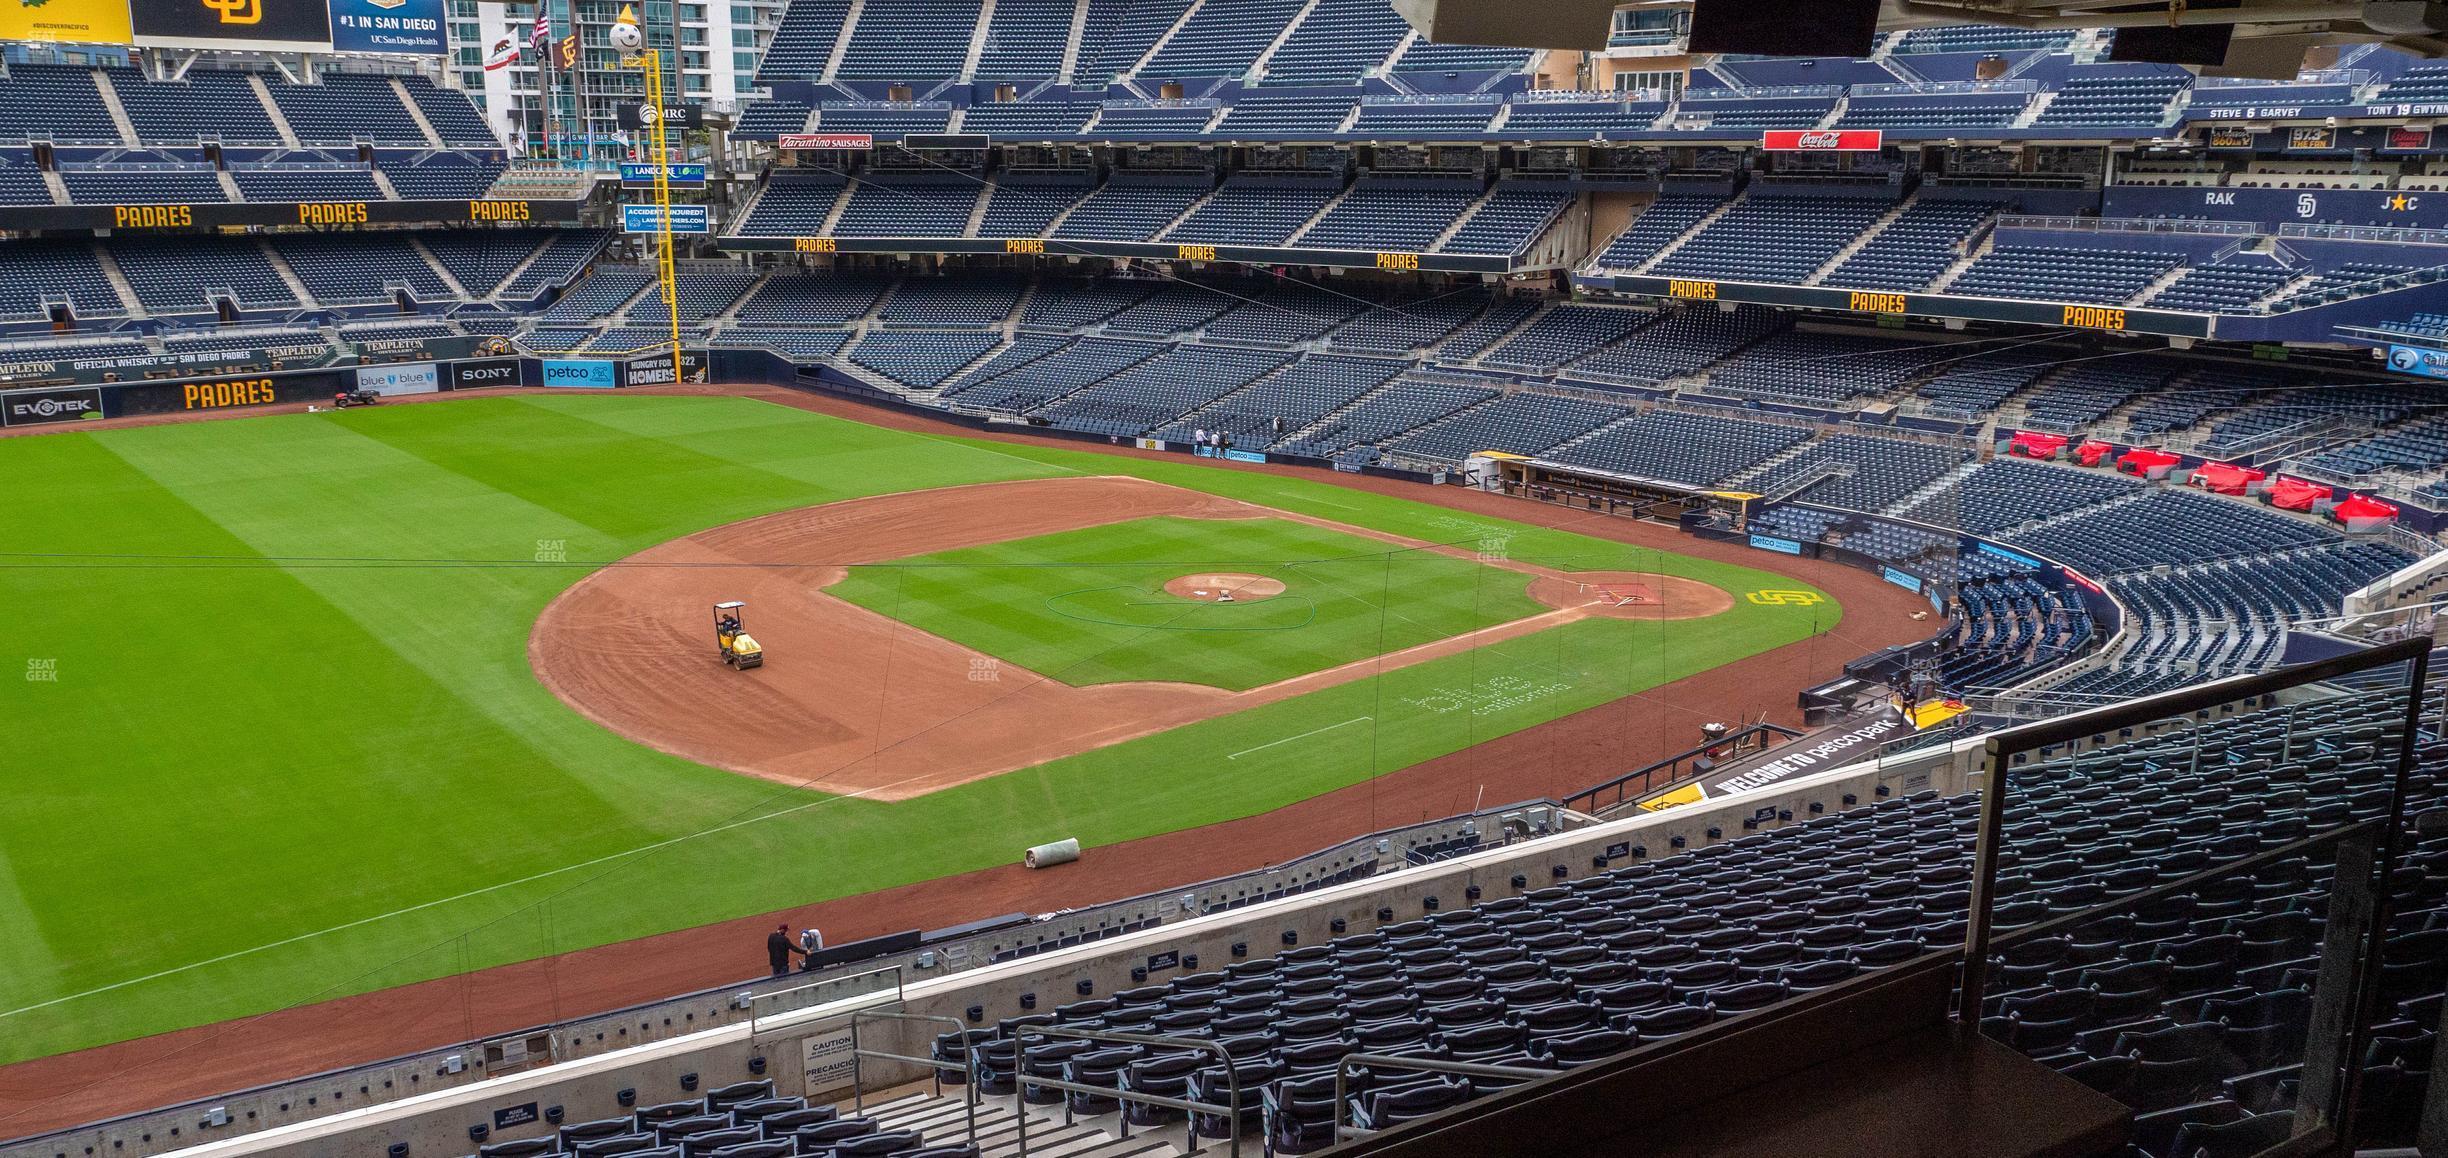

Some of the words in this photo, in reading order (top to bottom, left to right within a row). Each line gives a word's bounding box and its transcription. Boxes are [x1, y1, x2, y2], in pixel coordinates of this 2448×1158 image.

[32, 22, 90, 31] #DISCOVERPACIFICO
[340, 15, 355, 28] #1
[359, 16, 373, 28] IN
[375, 17, 400, 29] SAN
[403, 18, 437, 31] DIEGO
[371, 35, 383, 43] UC
[383, 35, 397, 44] San
[397, 36, 416, 47] Diego
[416, 37, 438, 46] Health
[2210, 109, 2242, 118] STEVE
[2246, 107, 2256, 118] 6
[2260, 107, 2302, 117] GARVEY
[2366, 106, 2394, 116] TONY
[2397, 104, 2411, 116] 19
[2293, 128, 2321, 141] 97.3
[781, 136, 830, 147] Tarantino
[678, 167, 703, 175] LOGIC
[2205, 192, 2236, 205] RAK
[115, 206, 192, 228] PADRES
[299, 203, 367, 224] PADRES
[470, 201, 529, 221] PADRES
[796, 239, 836, 252] PADRES
[1006, 239, 1044, 253] PADRES
[1179, 246, 1215, 260] PADRES
[1376, 253, 1418, 269] PADRES
[1669, 280, 1716, 299] PADRES
[1850, 292, 1906, 313] PADRES
[2062, 305, 2126, 330] PADRES
[265, 346, 327, 358] TEMPLETON
[365, 340, 424, 352] TEMPLETON
[74, 358, 116, 370] OFFICIAL
[117, 356, 158, 368] WHISKEY
[179, 354, 196, 363] SAN
[197, 353, 220, 362] DIEGO
[221, 351, 251, 360] PADRES
[631, 360, 657, 369] HUNGRY
[658, 358, 672, 368] FOR
[680, 356, 696, 366] 322
[399, 373, 424, 383] blue
[462, 367, 512, 380] SONY
[547, 366, 589, 381] petco
[629, 368, 676, 385] HOMERS
[360, 376, 385, 386] blue
[183, 379, 275, 410] PADRES
[1230, 451, 1248, 460] petco
[1752, 536, 1775, 547] petco
[1715, 757, 1800, 795] WELCOME
[1790, 751, 1818, 770] TO
[1806, 730, 1863, 760] petco
[1853, 717, 1899, 741] park
[812, 1036, 851, 1051] CAUTION
[805, 1058, 855, 1077] PRECAUCIÓ
